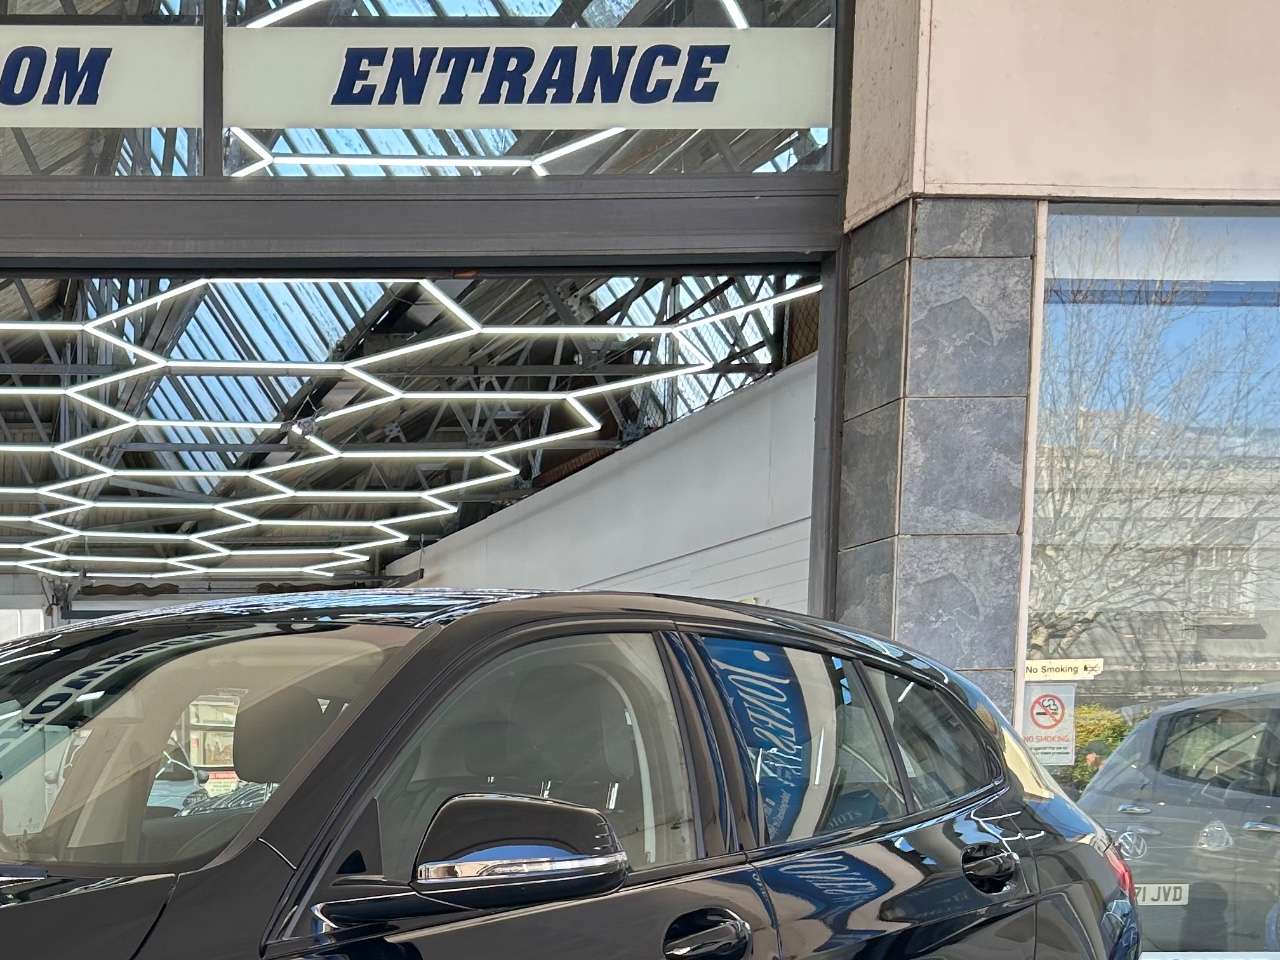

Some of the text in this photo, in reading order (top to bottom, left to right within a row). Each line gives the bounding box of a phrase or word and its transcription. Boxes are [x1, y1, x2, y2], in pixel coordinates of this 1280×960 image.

[330, 44, 731, 105] ENTRANCE
[1025, 665, 1079, 675] No Smoking
[1151, 886, 1183, 902] JVD
